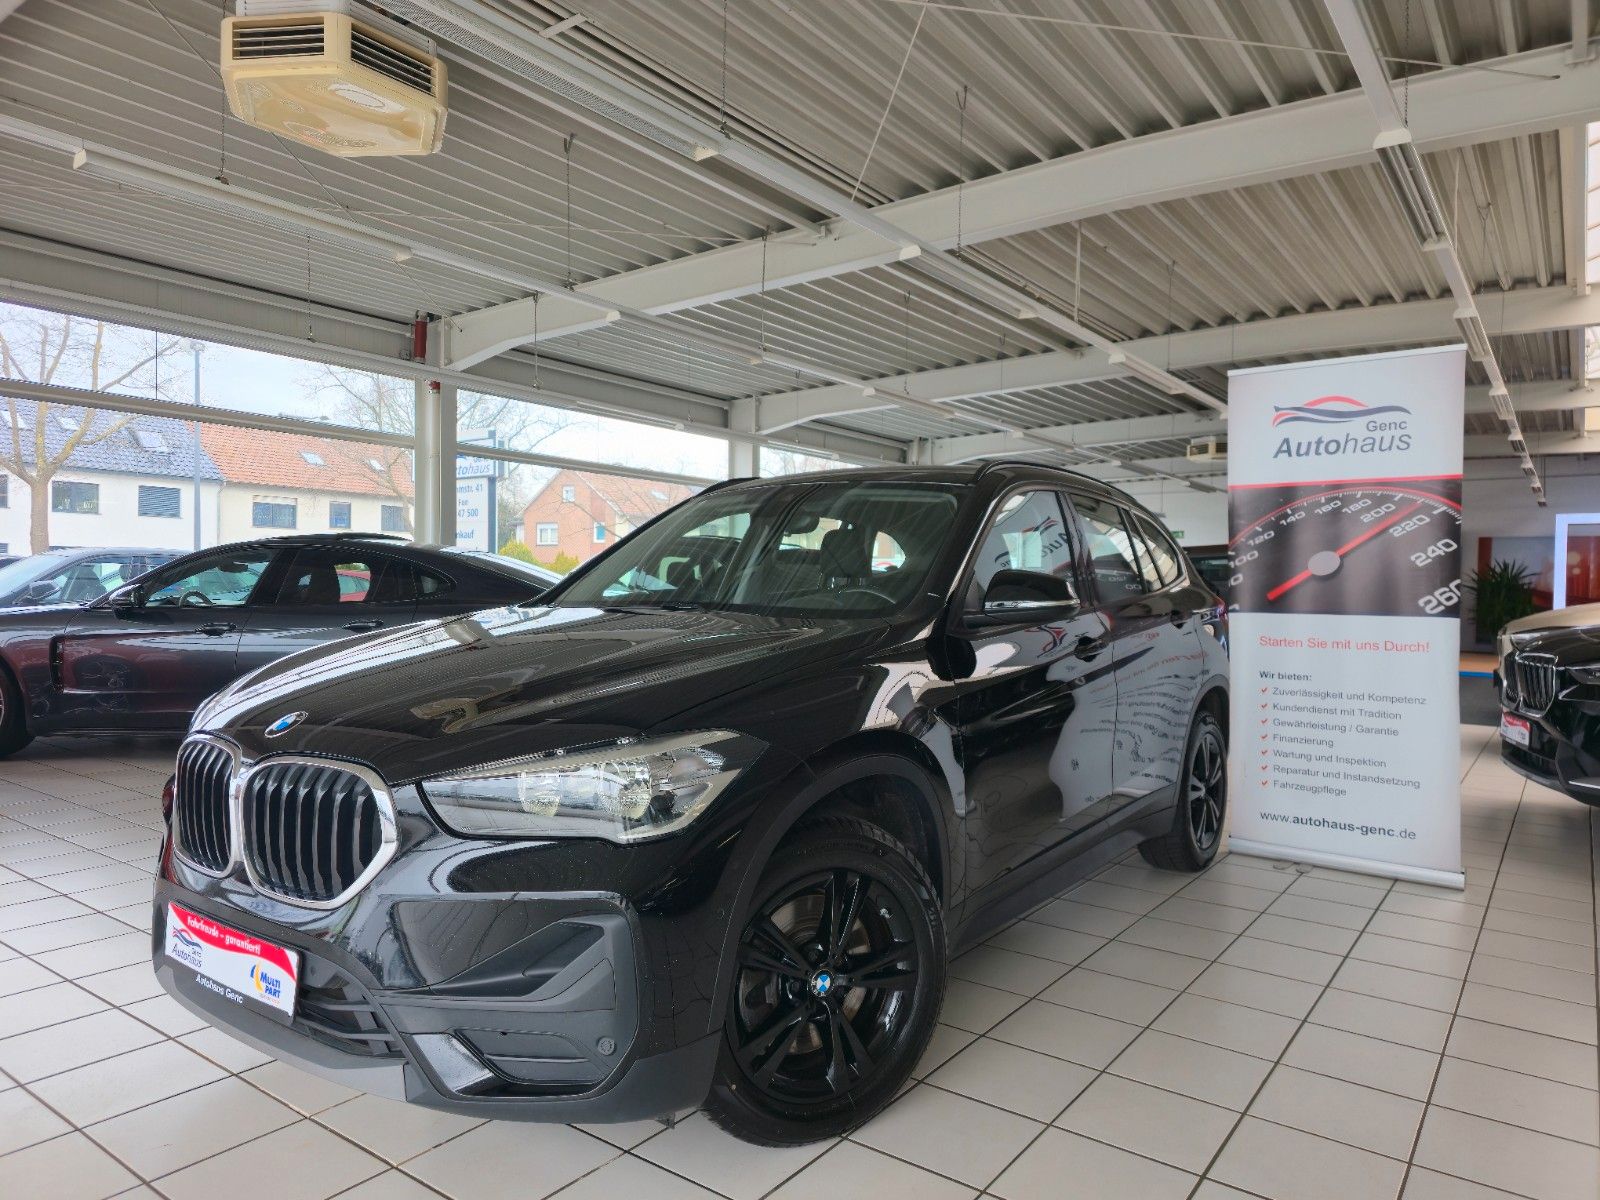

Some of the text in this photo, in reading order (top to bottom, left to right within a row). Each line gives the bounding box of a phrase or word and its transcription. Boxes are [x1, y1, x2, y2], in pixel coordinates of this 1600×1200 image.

[1366, 420, 1408, 432] Genc
[1272, 433, 1412, 459] Autohaus
[456, 464, 491, 475] tohaus
[1342, 499, 1372, 514] 180
[1360, 503, 1396, 523] 200
[1280, 511, 1306, 526] 140
[1389, 514, 1431, 537] 220
[1247, 530, 1275, 546] 120
[1228, 550, 1259, 568] 100
[1411, 538, 1458, 567] 240
[1229, 573, 1243, 587] 0
[1259, 635, 1430, 653] Starten Sie mit uns Durch!
[1259, 671, 1312, 681] Wir bieten:
[1272, 687, 1427, 705] Zuverlässigkeit und Kompetenz
[1272, 703, 1402, 720] Kundendienst mit Tradition
[1273, 718, 1347, 733] Gewährleistung
[1355, 724, 1399, 736] Garantie
[1273, 733, 1334, 748] Finanzierung
[1273, 749, 1387, 768] Wartung und Inspektion
[1273, 764, 1420, 790] Reparatur und Instandsetzung
[1273, 780, 1347, 796] Fahrzeugpflege
[1260, 811, 1417, 840] www.autohaus-genc.de
[195, 973, 225, 995] Autohaus
[225, 988, 243, 1004] Genc
[260, 971, 281, 989] MULTI
[264, 985, 281, 998] PART
